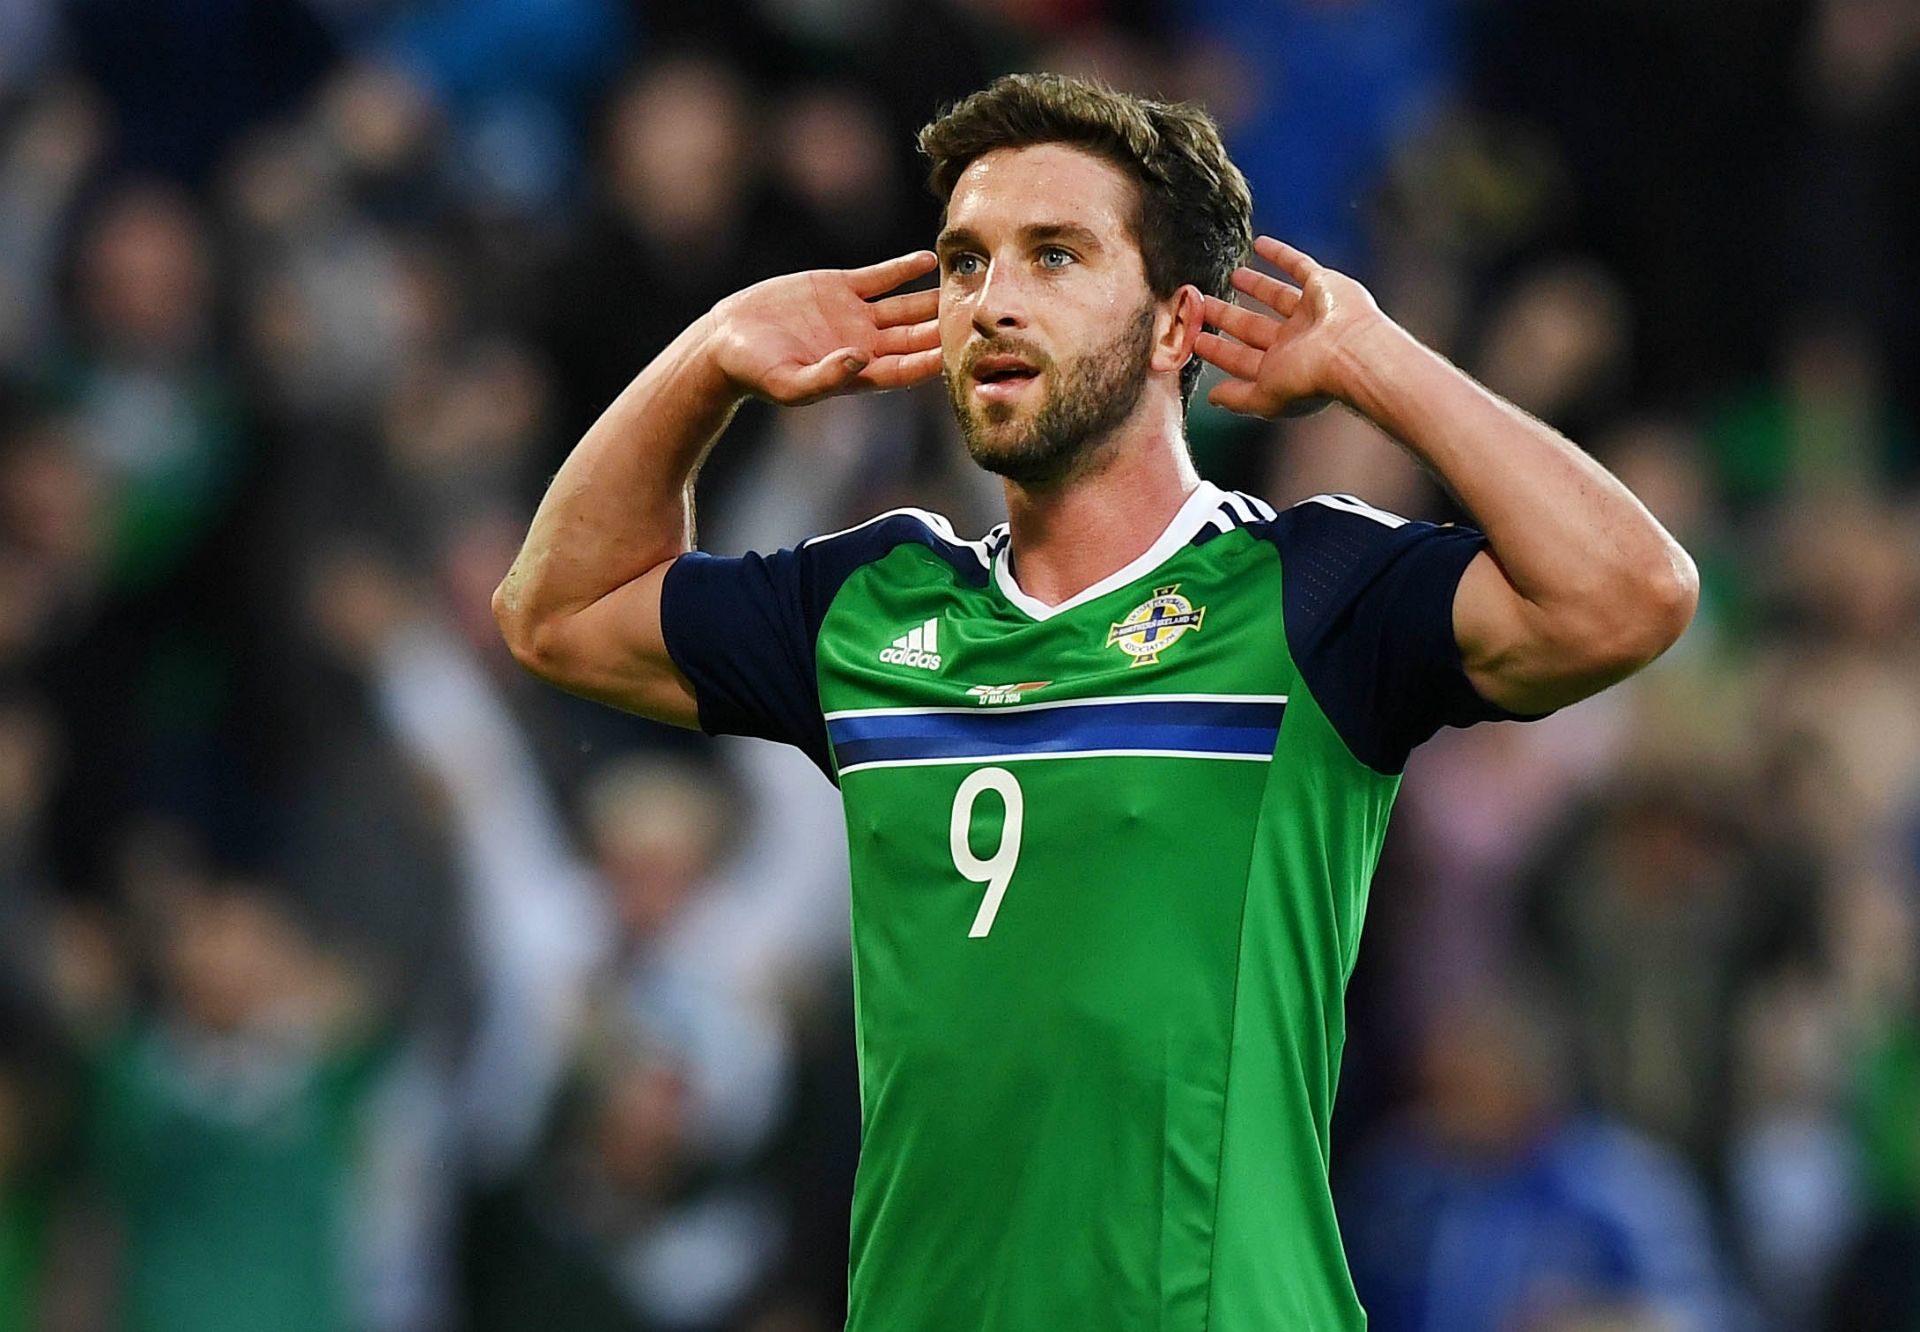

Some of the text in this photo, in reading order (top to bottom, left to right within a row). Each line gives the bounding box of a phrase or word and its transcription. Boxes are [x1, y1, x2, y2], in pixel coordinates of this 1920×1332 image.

[1158, 616, 1190, 628] IRELAND
[879, 648, 942, 671] adidas
[988, 694, 1005, 704] MAY
[950, 766, 1024, 938] 9
